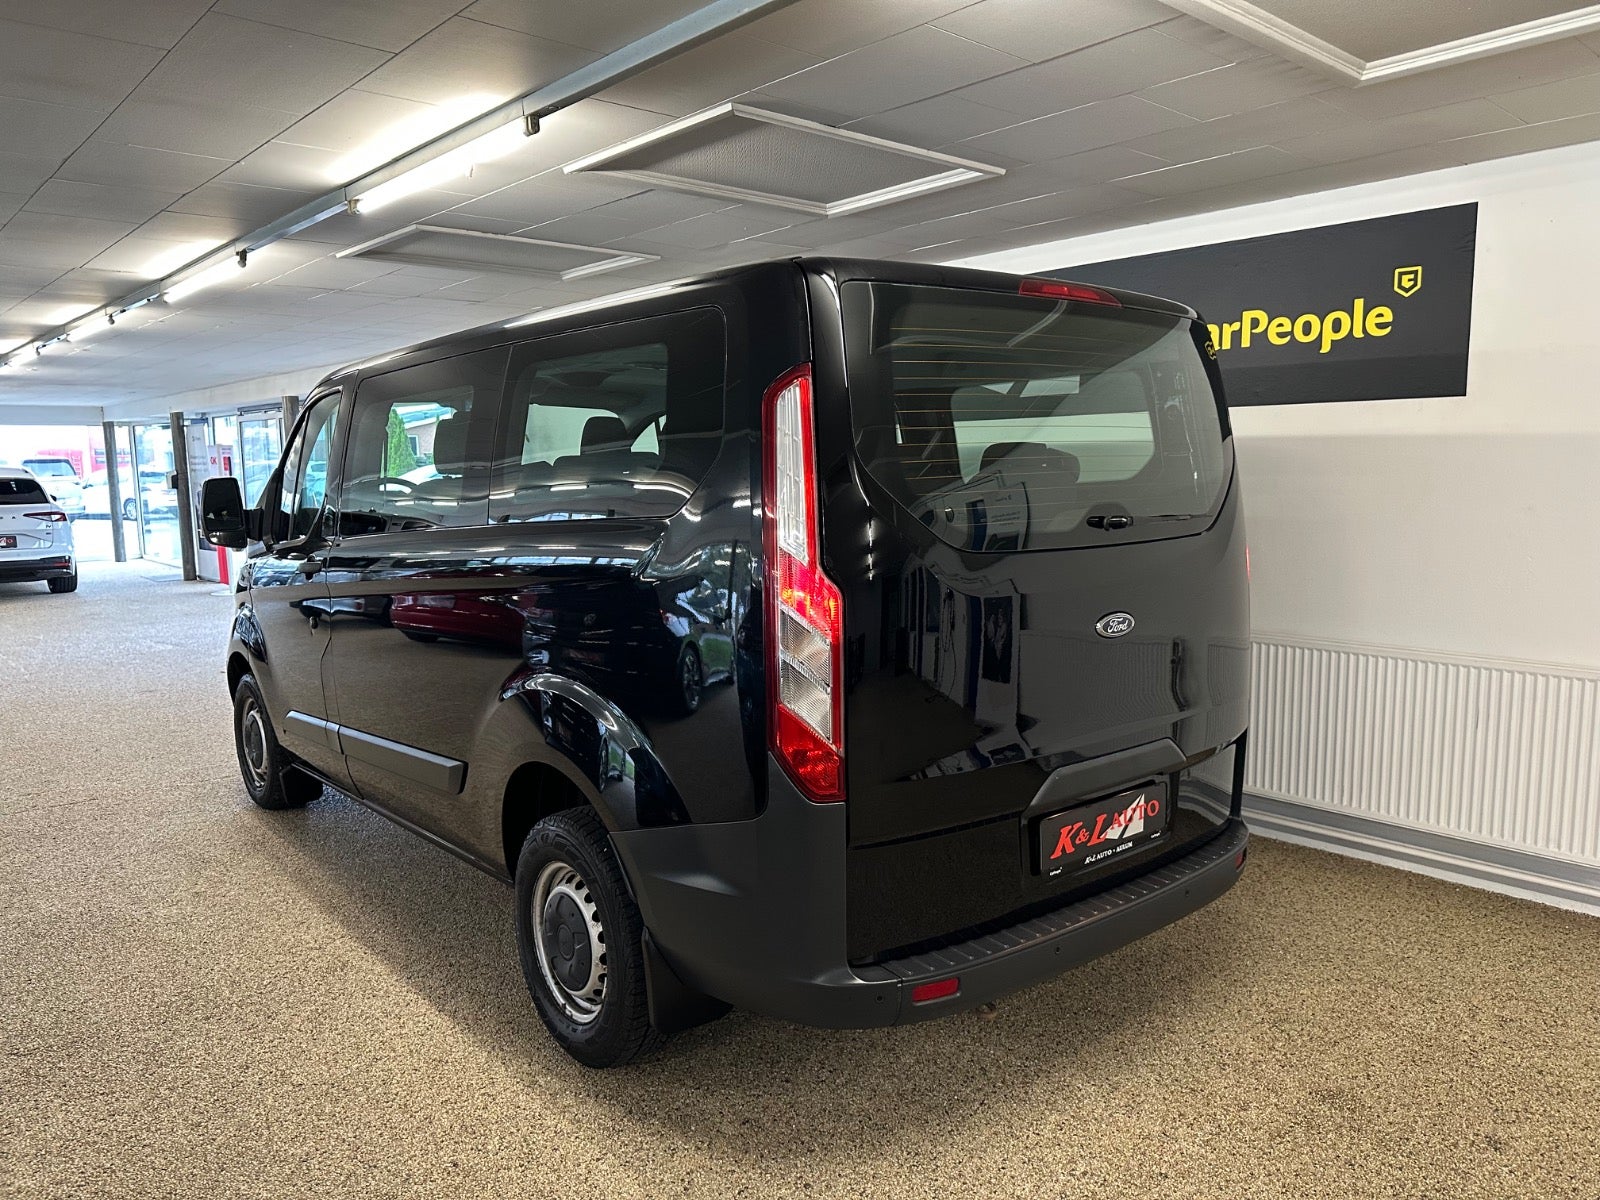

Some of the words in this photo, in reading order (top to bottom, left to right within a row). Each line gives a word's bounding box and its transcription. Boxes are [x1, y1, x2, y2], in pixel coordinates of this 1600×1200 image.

[1107, 617, 1129, 633] Ford
[1110, 800, 1160, 830] AUTO
[1096, 849, 1113, 860] AUTO
